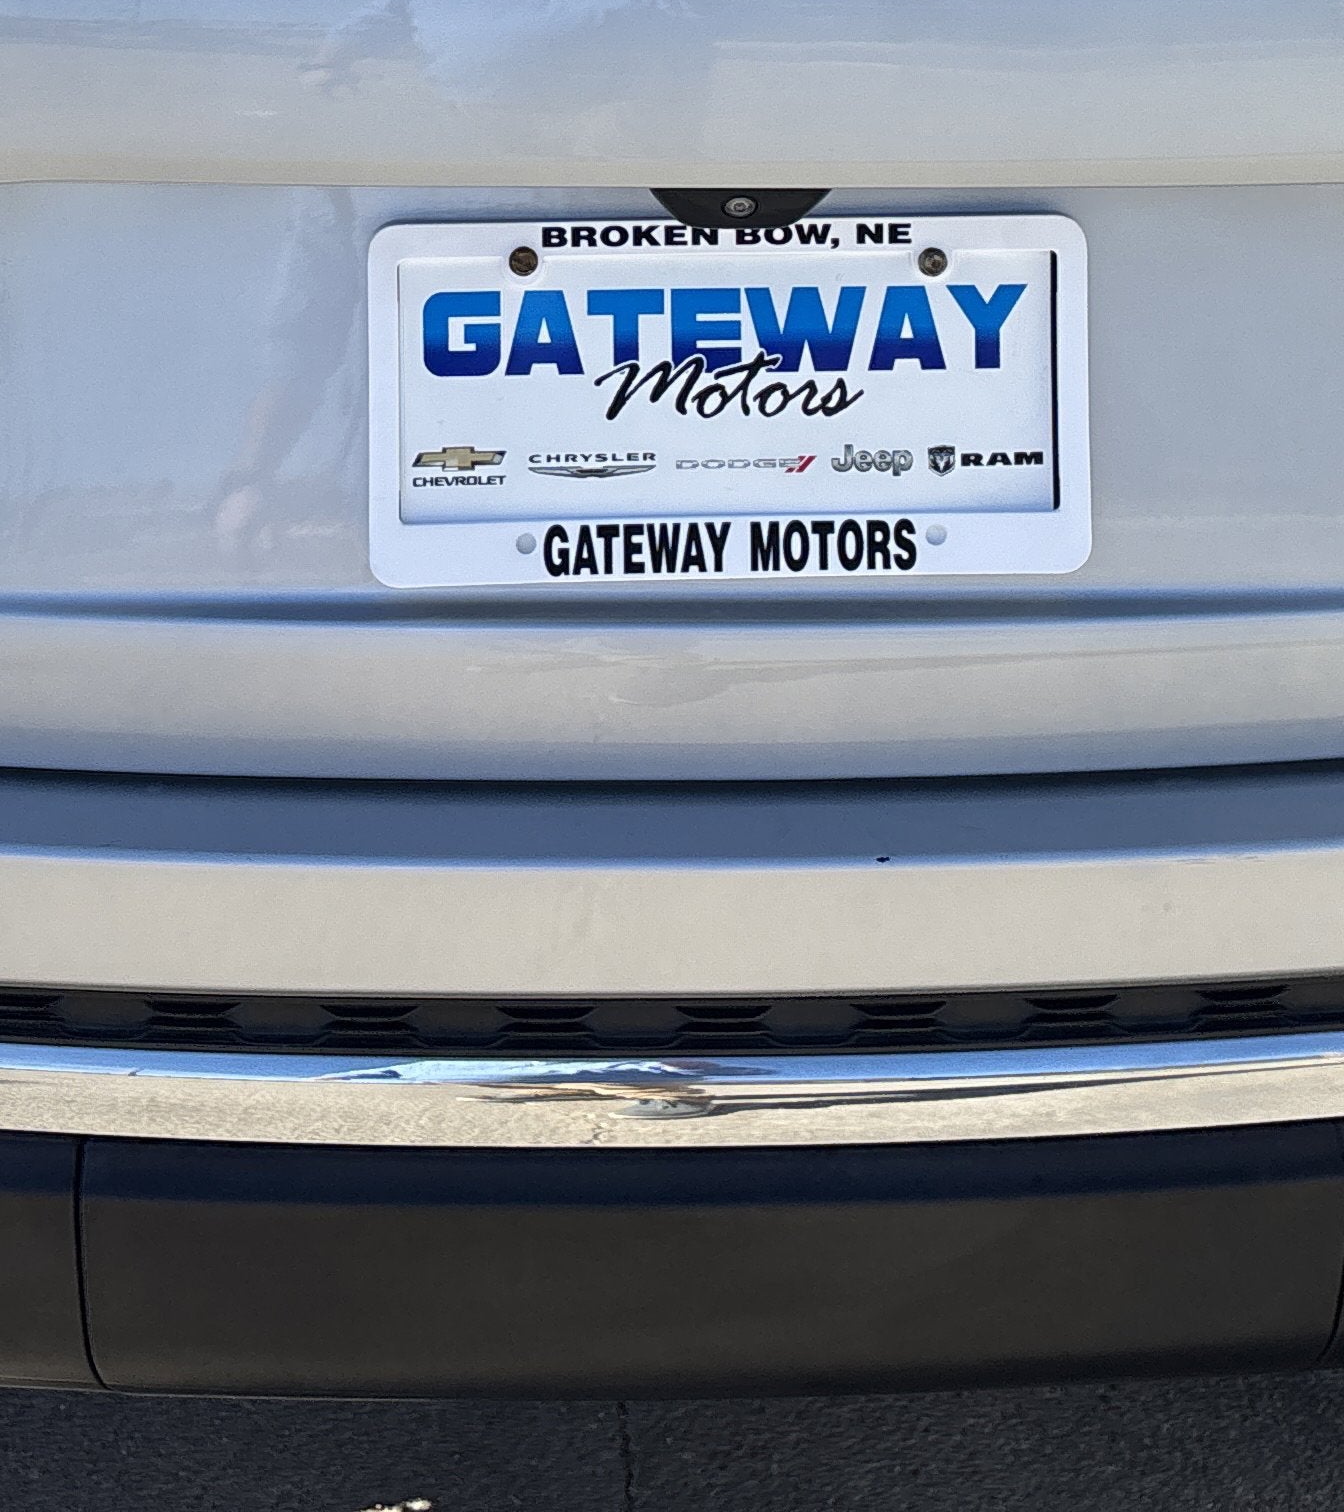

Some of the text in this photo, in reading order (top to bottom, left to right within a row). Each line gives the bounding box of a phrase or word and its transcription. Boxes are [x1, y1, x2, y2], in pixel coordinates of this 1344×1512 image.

[541, 223, 913, 250] BROKEN BOW, NE
[422, 283, 1027, 377] GATEWAY
[594, 352, 864, 420] Motors
[528, 452, 657, 464] CHRYSLER
[675, 457, 801, 470] DODGE
[831, 444, 913, 477] Jeep
[960, 451, 1044, 466] RAM
[412, 475, 507, 488] CHEVROLET
[543, 519, 917, 576] GATEWAY MOTORS
